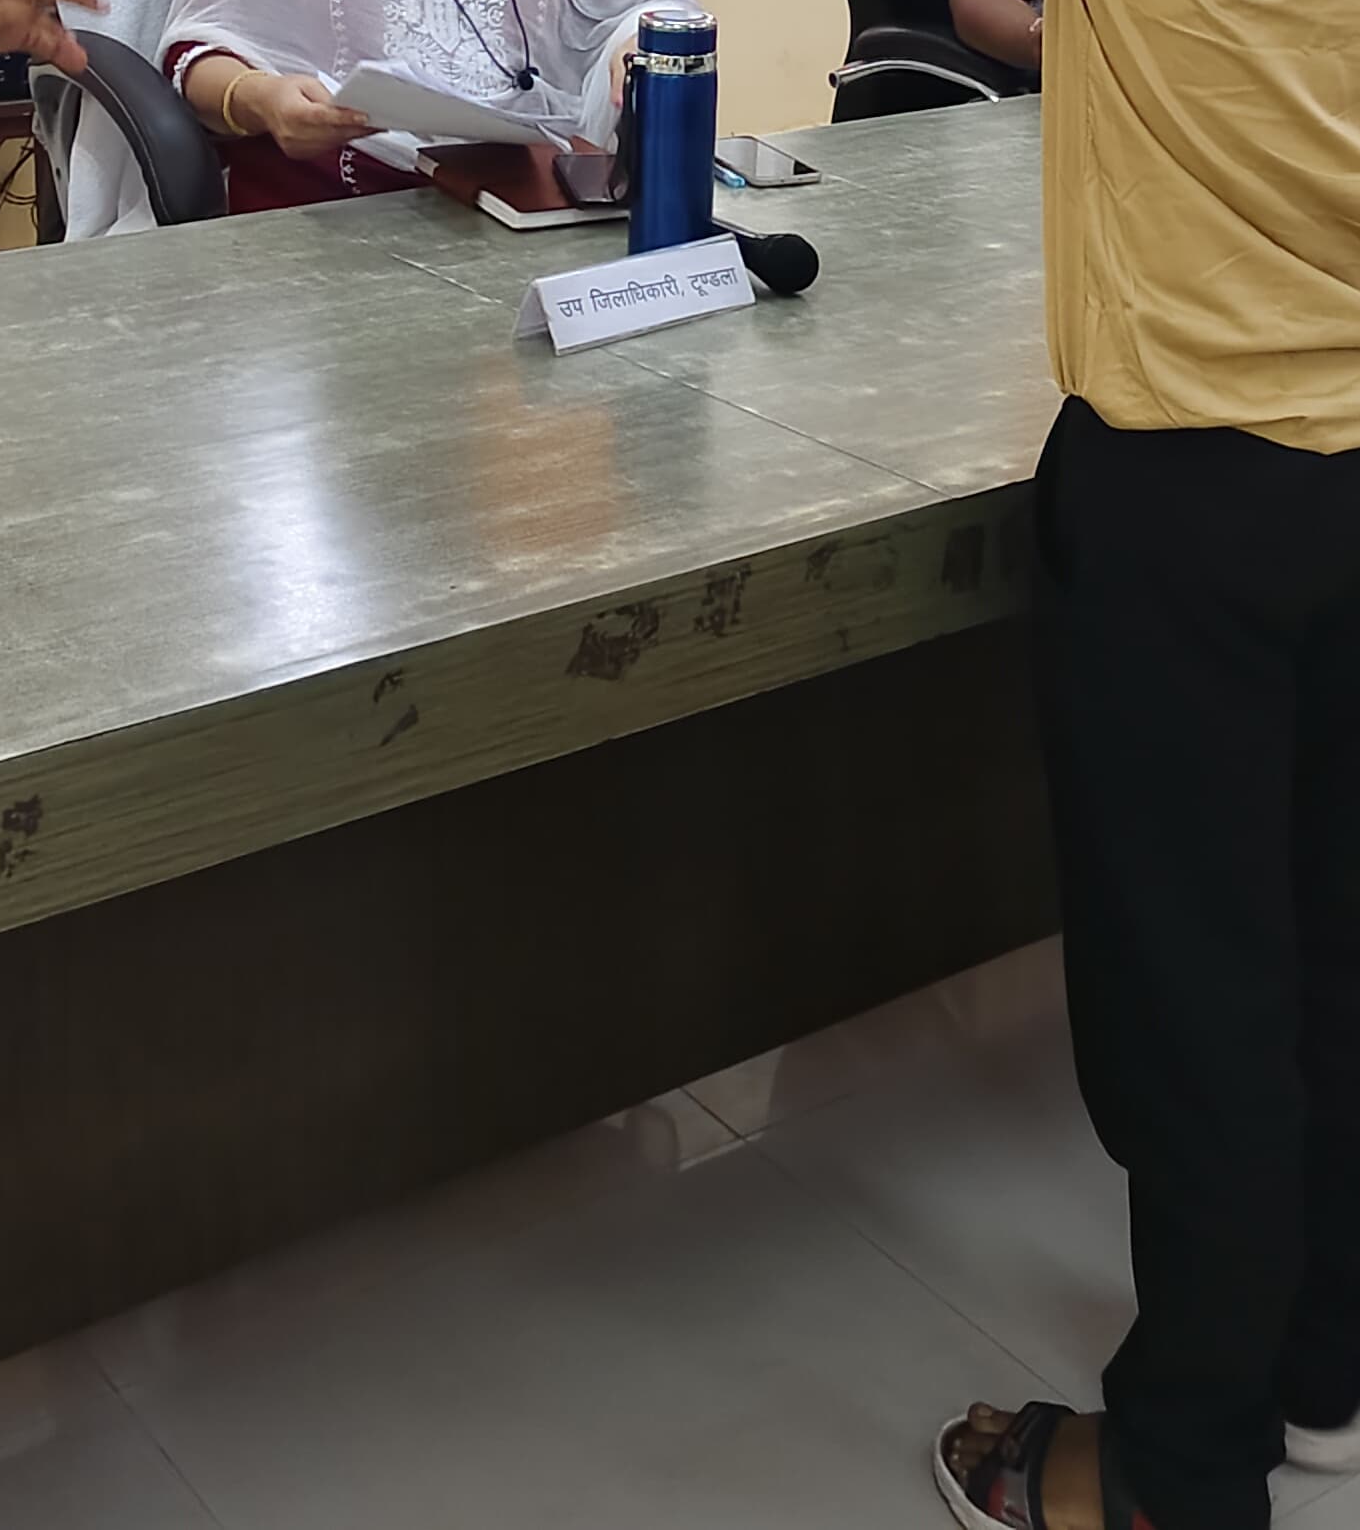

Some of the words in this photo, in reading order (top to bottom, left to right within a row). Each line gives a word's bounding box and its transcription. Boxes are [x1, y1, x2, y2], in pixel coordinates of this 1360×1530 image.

[556, 299, 585, 318] उप
[589, 274, 685, 313] जिलाधिकारी,
[688, 267, 739, 297] टूण्डला
